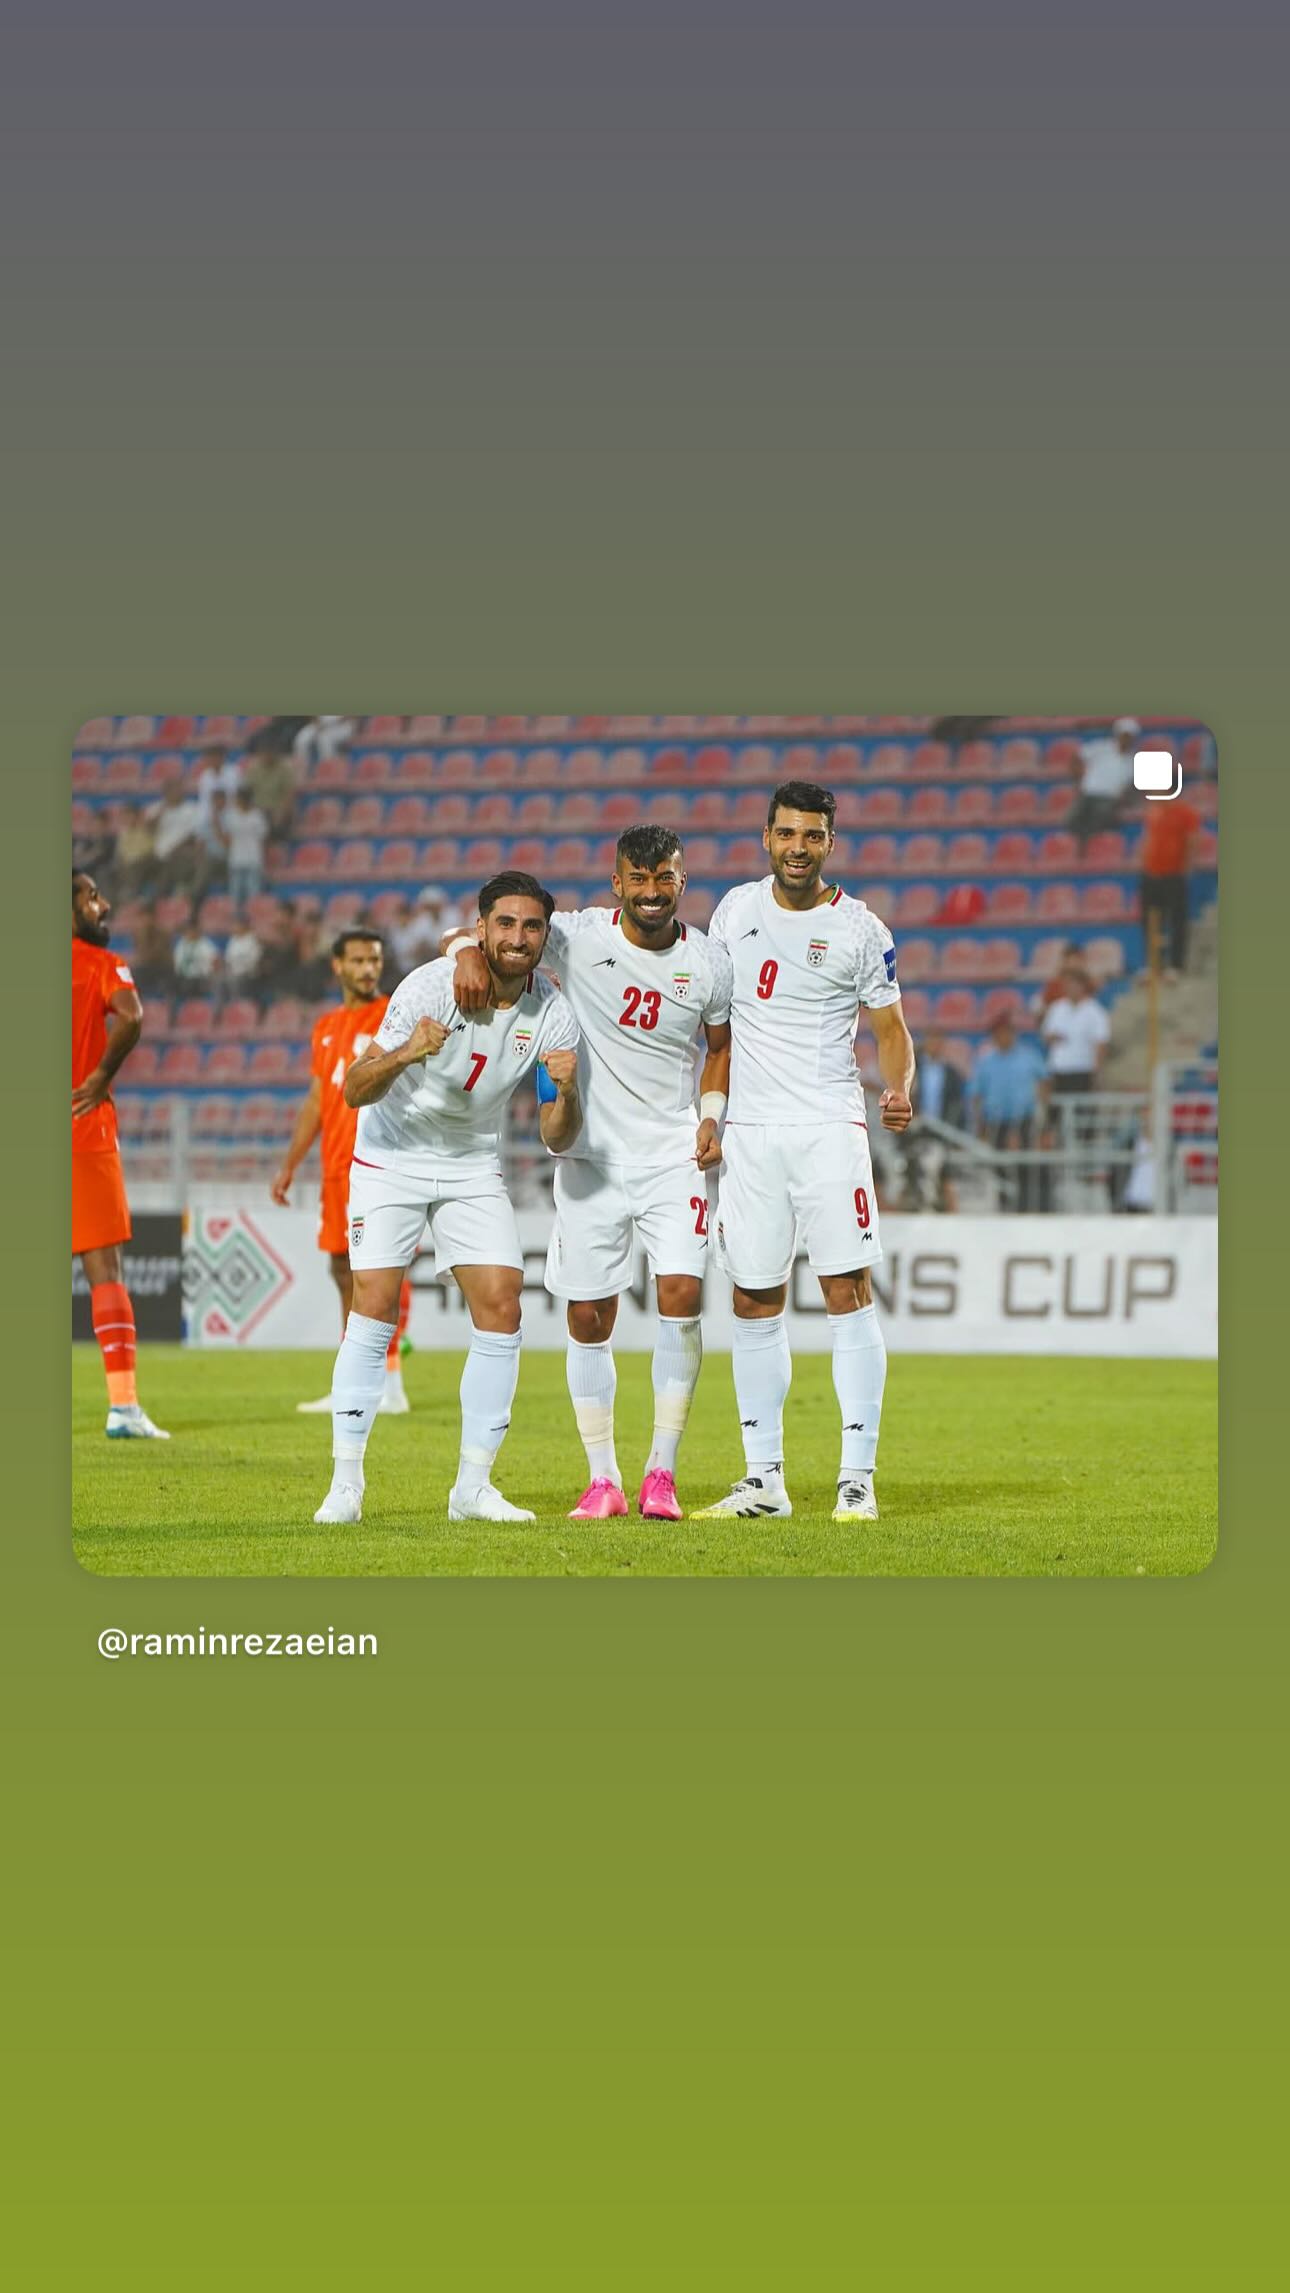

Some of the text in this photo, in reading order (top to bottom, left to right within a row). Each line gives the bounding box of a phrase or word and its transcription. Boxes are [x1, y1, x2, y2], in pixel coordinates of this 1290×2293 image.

[756, 959, 779, 1000] 9
[618, 986, 662, 1031] 23
[462, 1052, 488, 1093] 7
[689, 1196, 708, 1236] 2
[853, 1187, 871, 1229] 9
[1003, 1254, 1178, 1320] CUP
